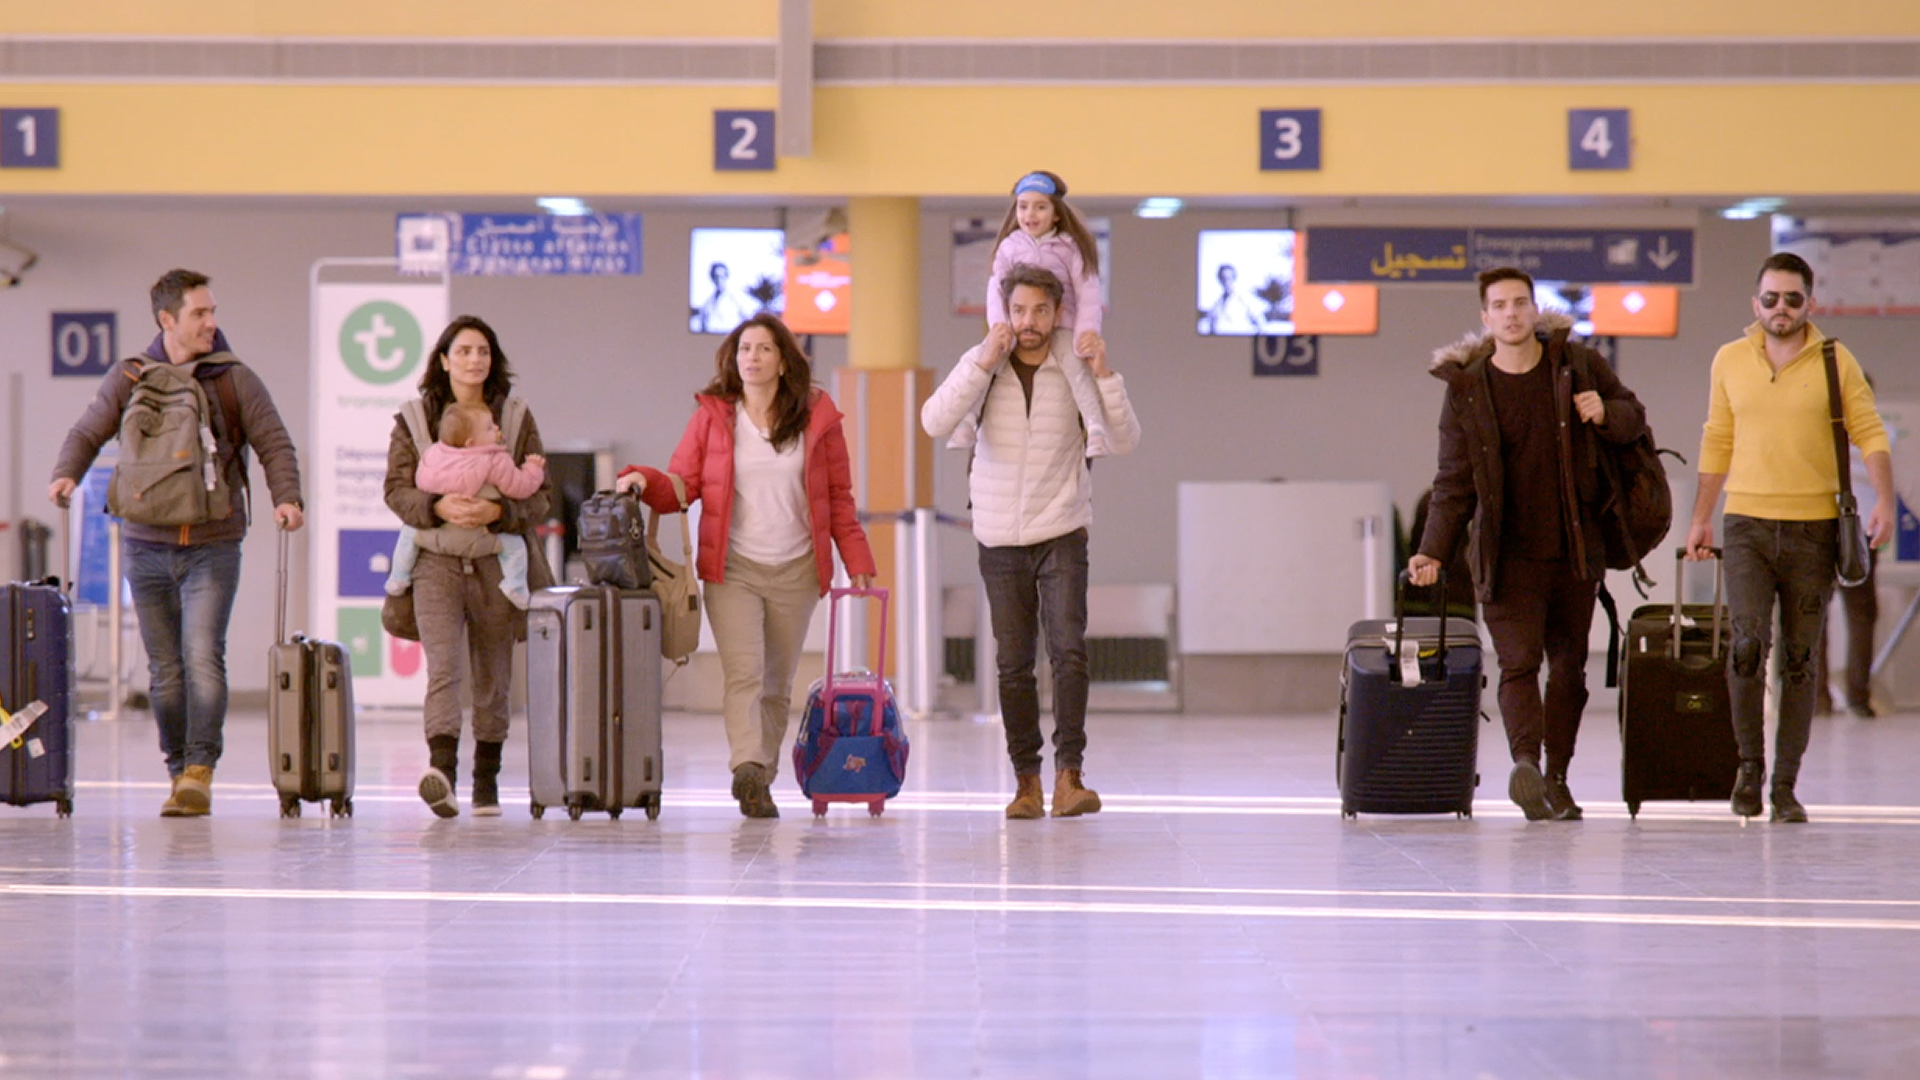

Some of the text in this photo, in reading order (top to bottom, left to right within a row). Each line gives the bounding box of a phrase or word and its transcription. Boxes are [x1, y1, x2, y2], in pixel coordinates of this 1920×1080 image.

[16, 115, 37, 157] 1
[729, 117, 758, 160] 2
[1274, 117, 1302, 160] 3
[1581, 116, 1614, 158] 4
[1371, 242, 1467, 278] تسجيل
[1475, 234, 1594, 252] Enregistrement
[57, 321, 111, 367] 01
[353, 313, 406, 373] t
